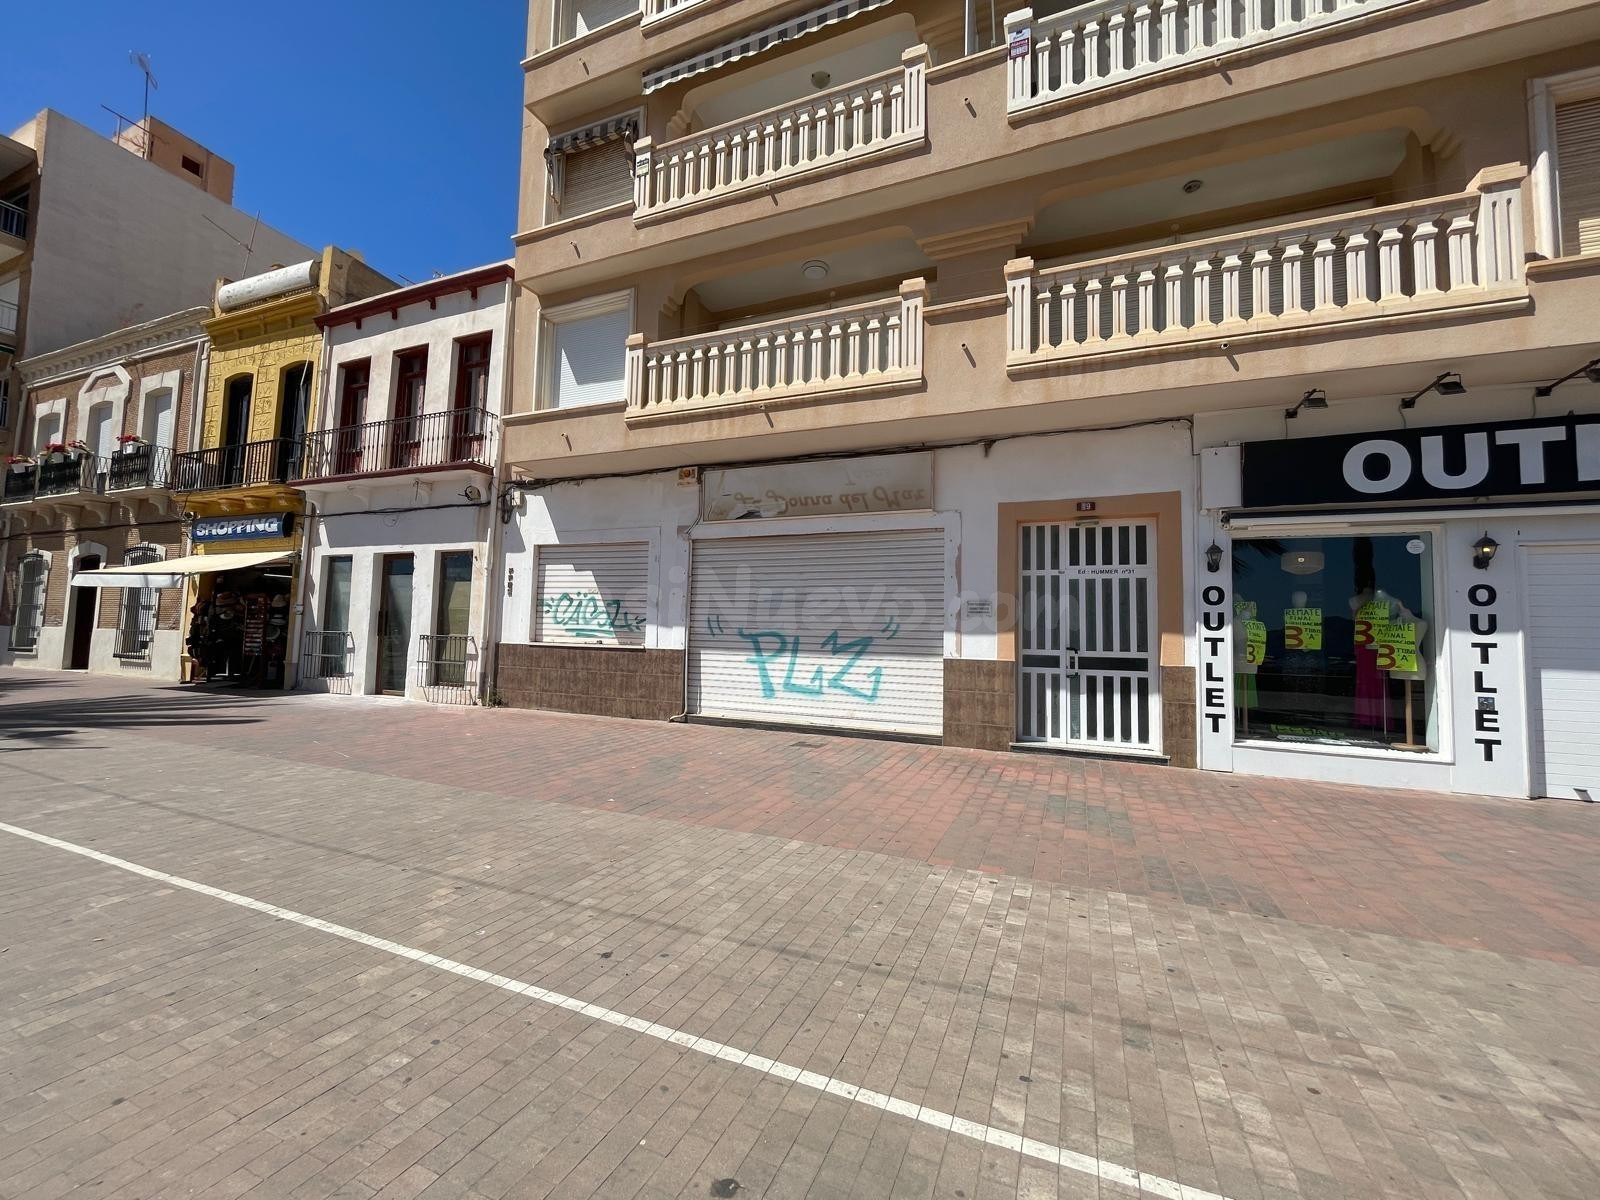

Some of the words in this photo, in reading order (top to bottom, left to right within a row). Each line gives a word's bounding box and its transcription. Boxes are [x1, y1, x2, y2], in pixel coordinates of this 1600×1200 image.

[196, 518, 278, 536] SHOPPING
[1285, 608, 1320, 616] REMATE
[1285, 626, 1304, 649] 3
[1202, 585, 1226, 733] OUTLET
[1377, 643, 1396, 670] 3
[1467, 583, 1502, 762] OUTLET
